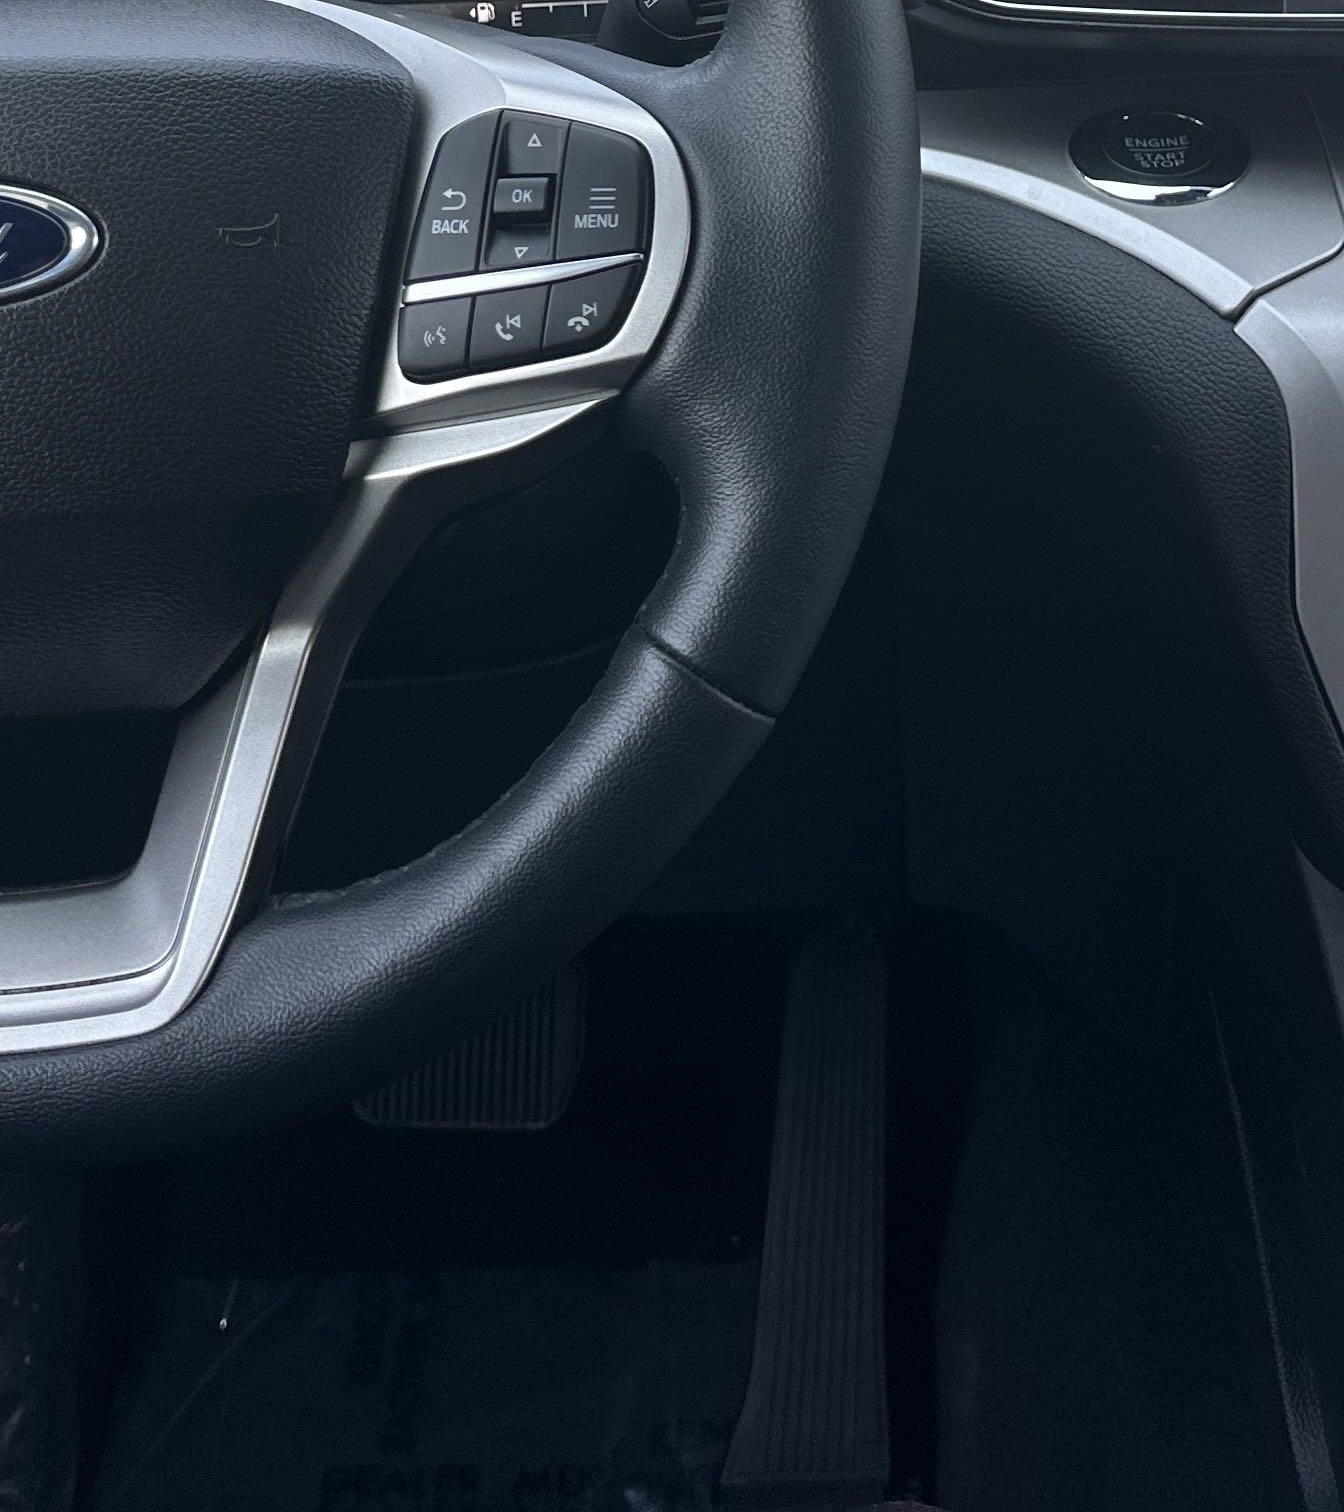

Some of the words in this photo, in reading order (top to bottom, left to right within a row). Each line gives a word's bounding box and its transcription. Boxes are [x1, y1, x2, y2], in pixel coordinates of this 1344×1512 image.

[510, 10, 523, 28] E
[1124, 135, 1190, 148] ENGINE
[1133, 150, 1187, 162] START
[1139, 160, 1186, 169] STOP
[511, 189, 533, 204] OK
[431, 219, 470, 235] BACK
[574, 214, 620, 230] MENU
